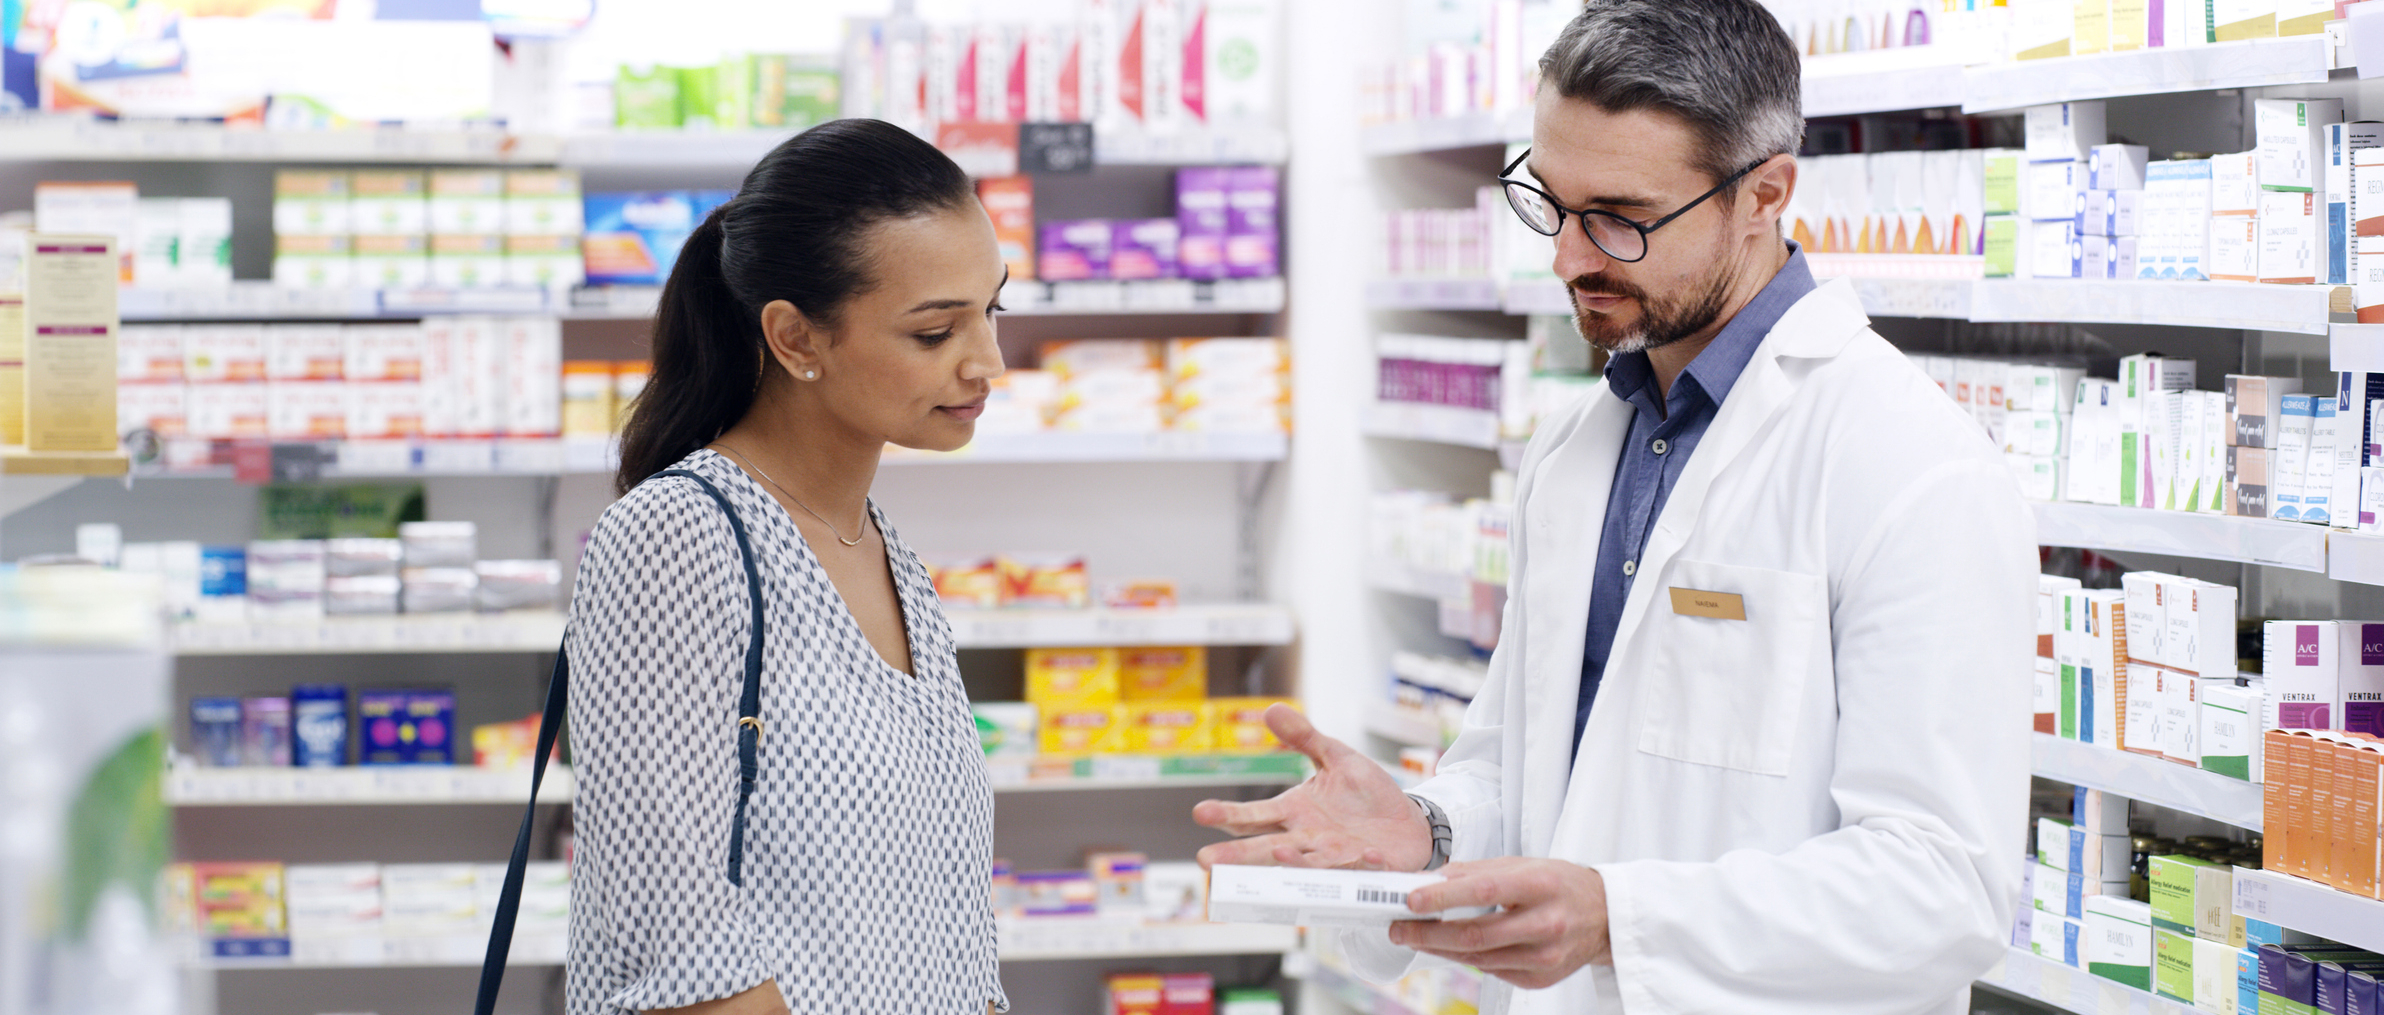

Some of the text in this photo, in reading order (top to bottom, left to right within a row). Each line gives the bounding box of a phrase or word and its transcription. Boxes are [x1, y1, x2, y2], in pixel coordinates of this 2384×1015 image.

[2341, 391, 2349, 406] N
[1695, 600, 1719, 608] NAIEMA
[2298, 644, 2317, 654] A/C
[2364, 643, 2382, 653] A/C
[2282, 693, 2316, 701] VENTRAX
[2348, 692, 2382, 700] VENTRAX
[2150, 879, 2190, 894] Allergy Relief medication
[2106, 929, 2134, 948] HAMILYN
[2158, 952, 2191, 969] Allergy Relief medication
